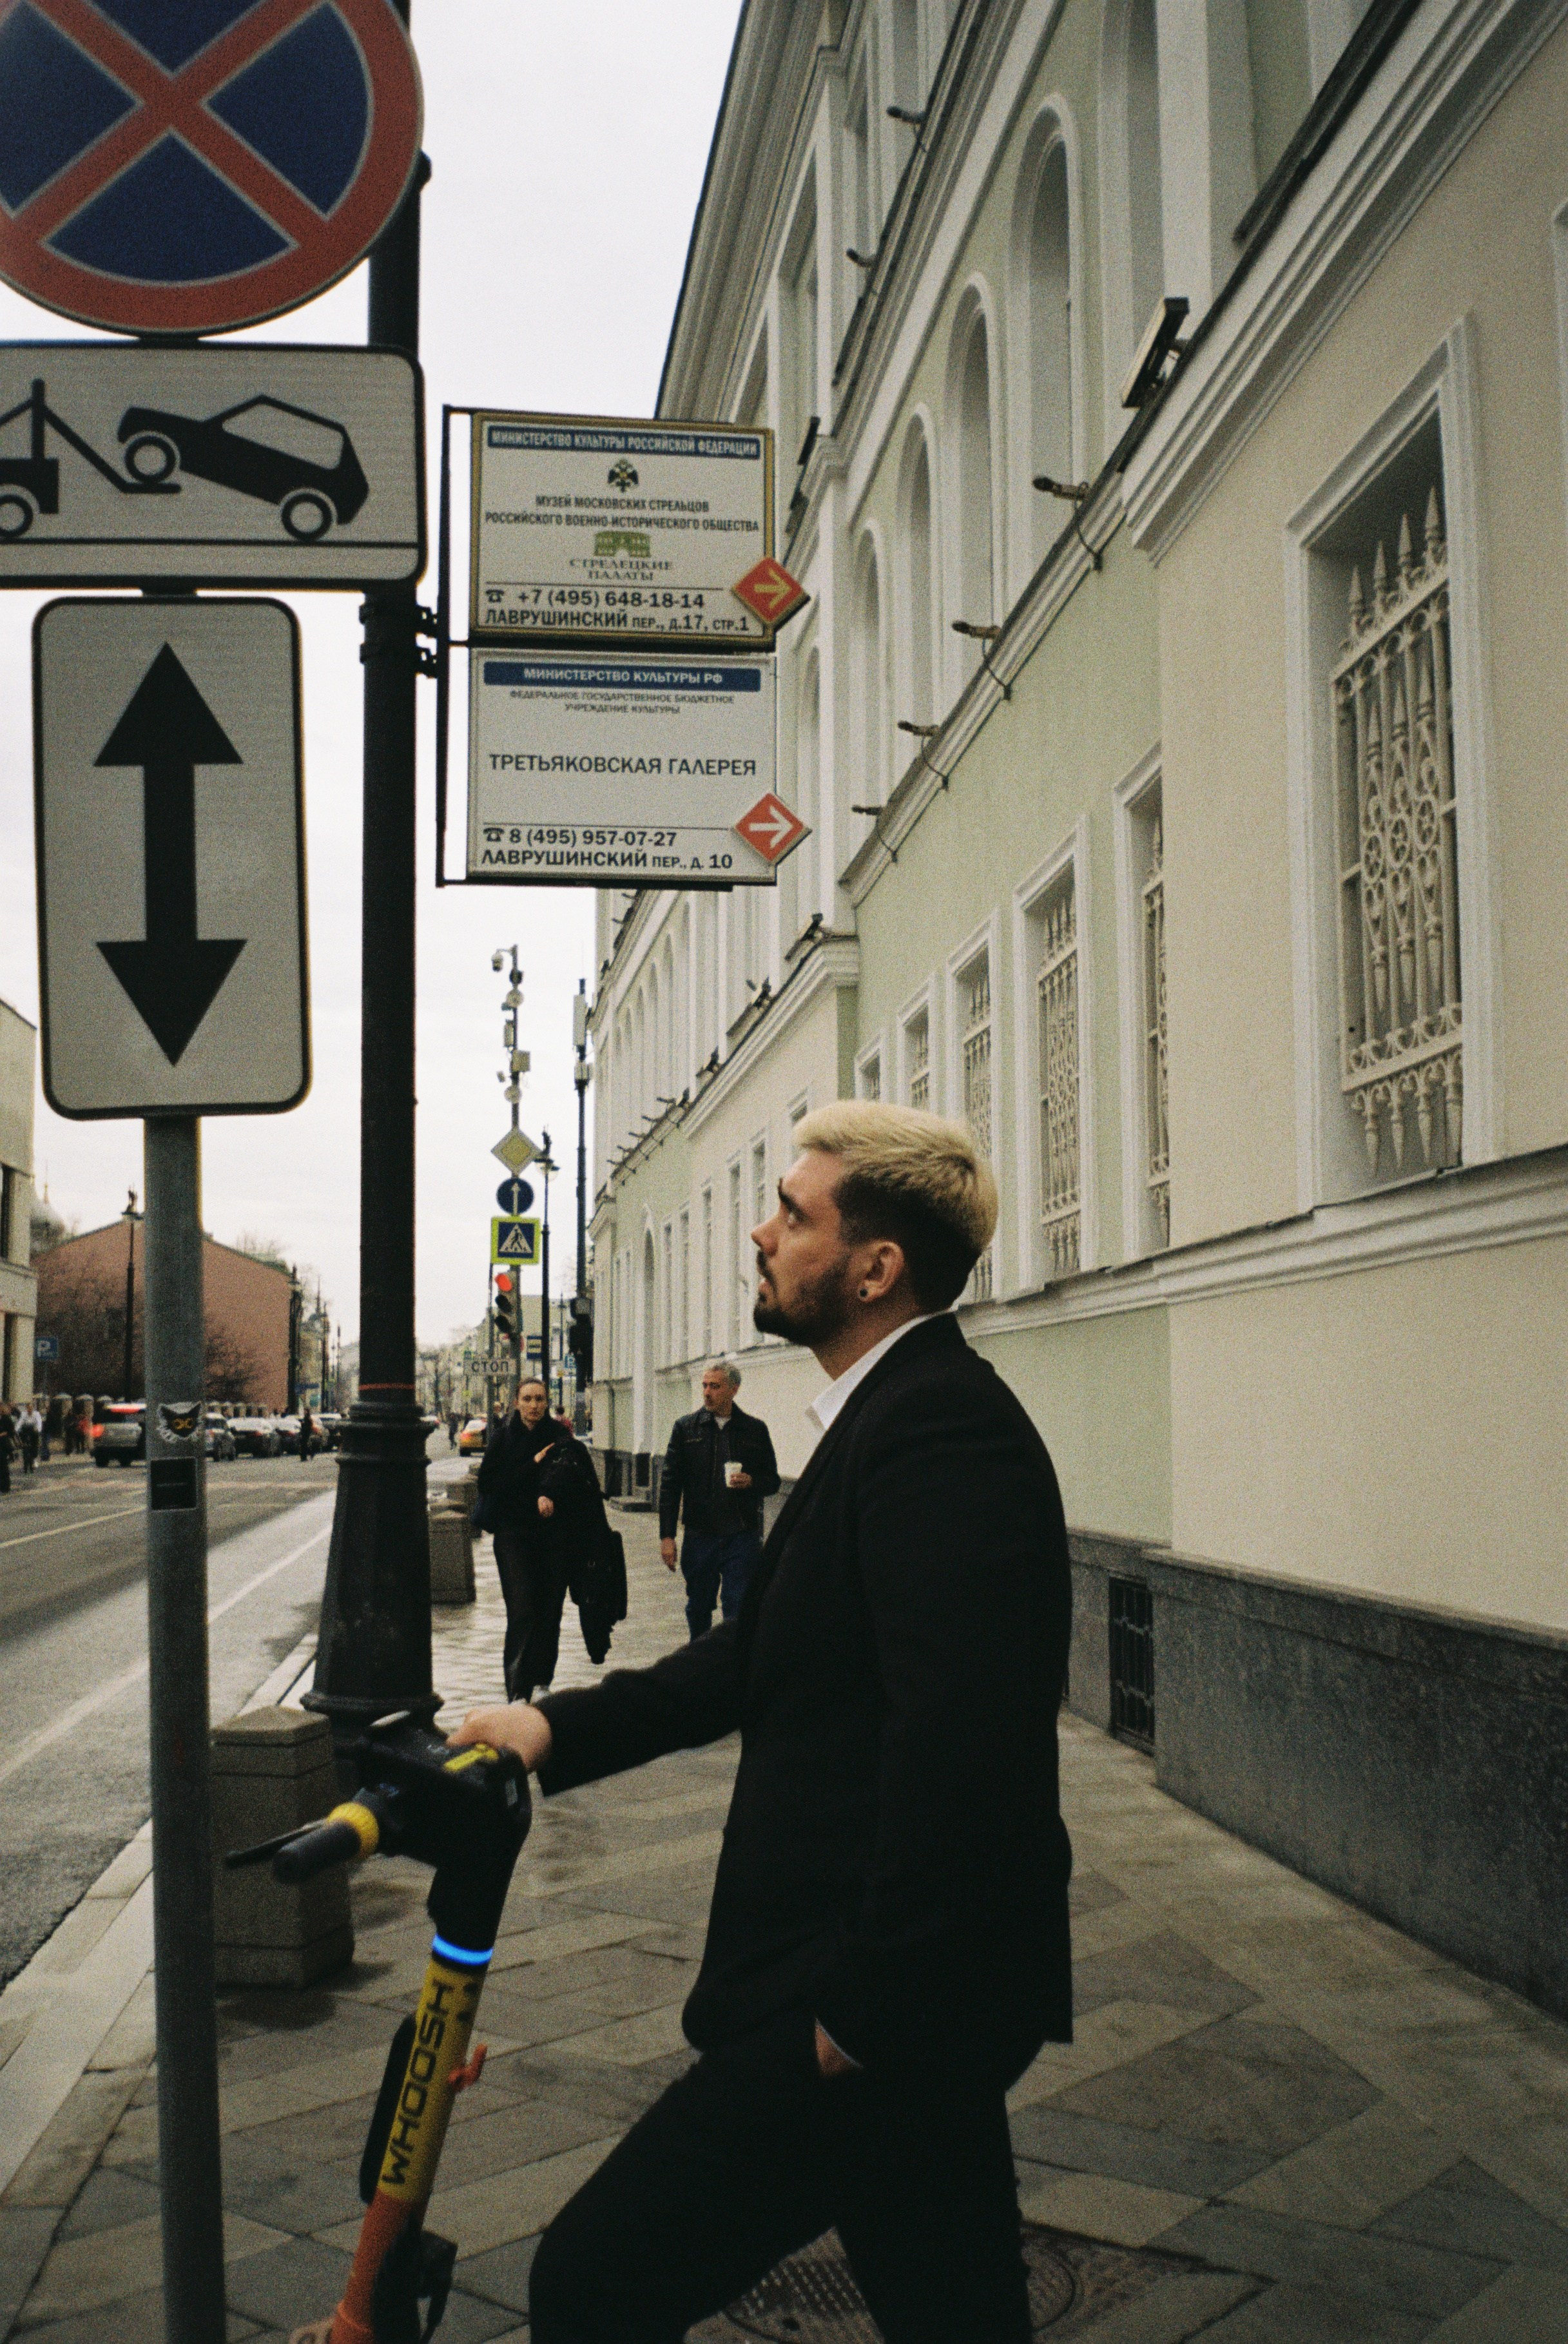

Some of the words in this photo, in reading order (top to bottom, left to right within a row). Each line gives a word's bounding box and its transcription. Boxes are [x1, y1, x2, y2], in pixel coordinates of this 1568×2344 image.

[649, 499, 709, 512] СТРЕЛЬЦОВ
[702, 518, 759, 532] ОБЩЕСТВА
[518, 589, 541, 605] +7
[548, 590, 599, 608] (495)
[605, 590, 704, 608] 648-18-14
[485, 608, 628, 628] ЛАВРУШИНСКИЙ
[524, 668, 630, 682] МИНИСТЕРСТВО
[634, 671, 701, 684] КУЛЬТУРЫ
[704, 673, 723, 684] РФ
[489, 753, 661, 773] ТРЕТЬЯКОВСКАЯ
[668, 758, 756, 775] ГАЛЕРЕЯ
[508, 828, 522, 844] 8
[527, 829, 576, 847] (495)
[581, 830, 677, 847] 957-07-27
[481, 849, 648, 867] ЛАВРУШИНСКИЙ
[709, 854, 733, 869] 10
[471, 1361, 509, 1373] СТОП
[382, 1979, 452, 2184] WHOOSH
